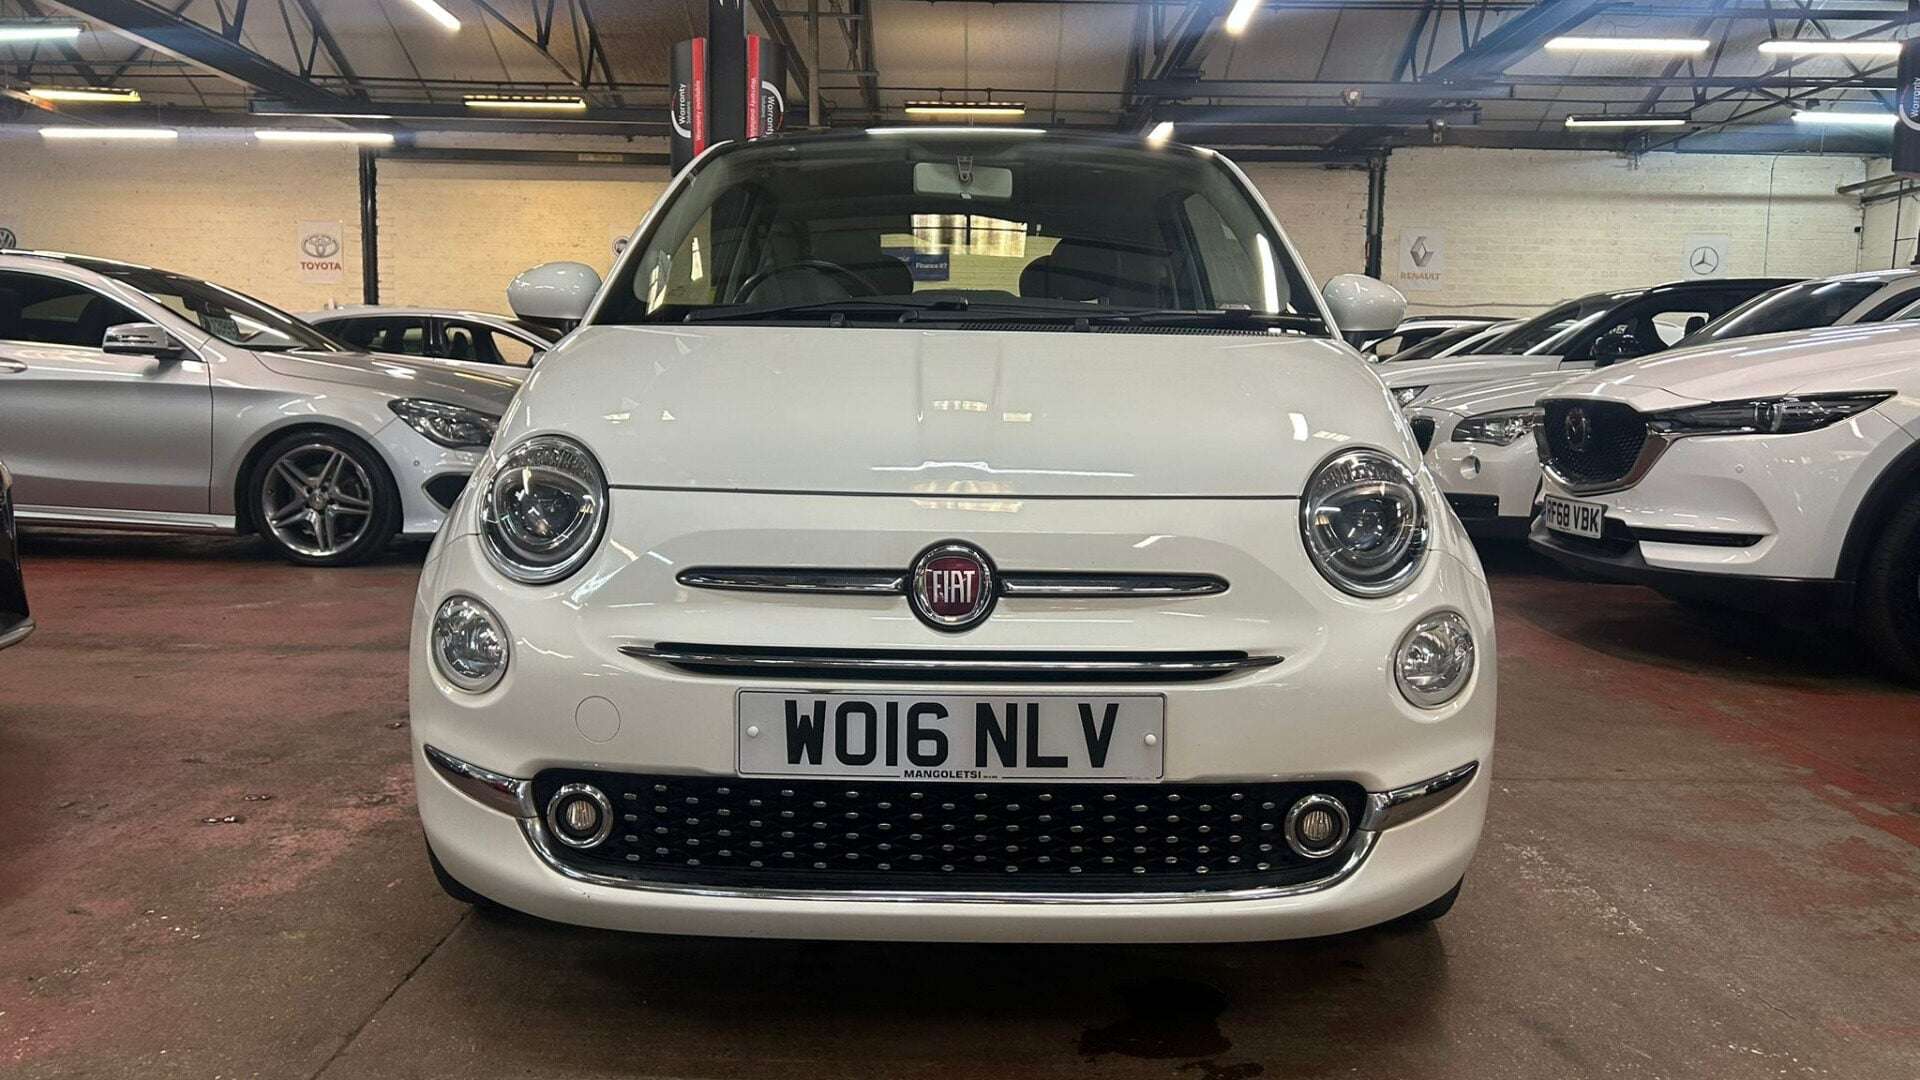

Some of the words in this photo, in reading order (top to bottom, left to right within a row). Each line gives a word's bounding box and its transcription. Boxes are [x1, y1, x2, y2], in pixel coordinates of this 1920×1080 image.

[678, 83, 687, 125] Warranty
[765, 95, 775, 135] Warranty
[300, 261, 342, 271] TOYOTA
[1400, 271, 1442, 280] RENAULT
[1546, 500, 1570, 527] RF68
[1573, 504, 1600, 532] VBK
[932, 570, 976, 603] FIAT
[785, 699, 949, 767] WO16
[975, 702, 1120, 768] NLV
[903, 770, 981, 779] MANGOLETSI
